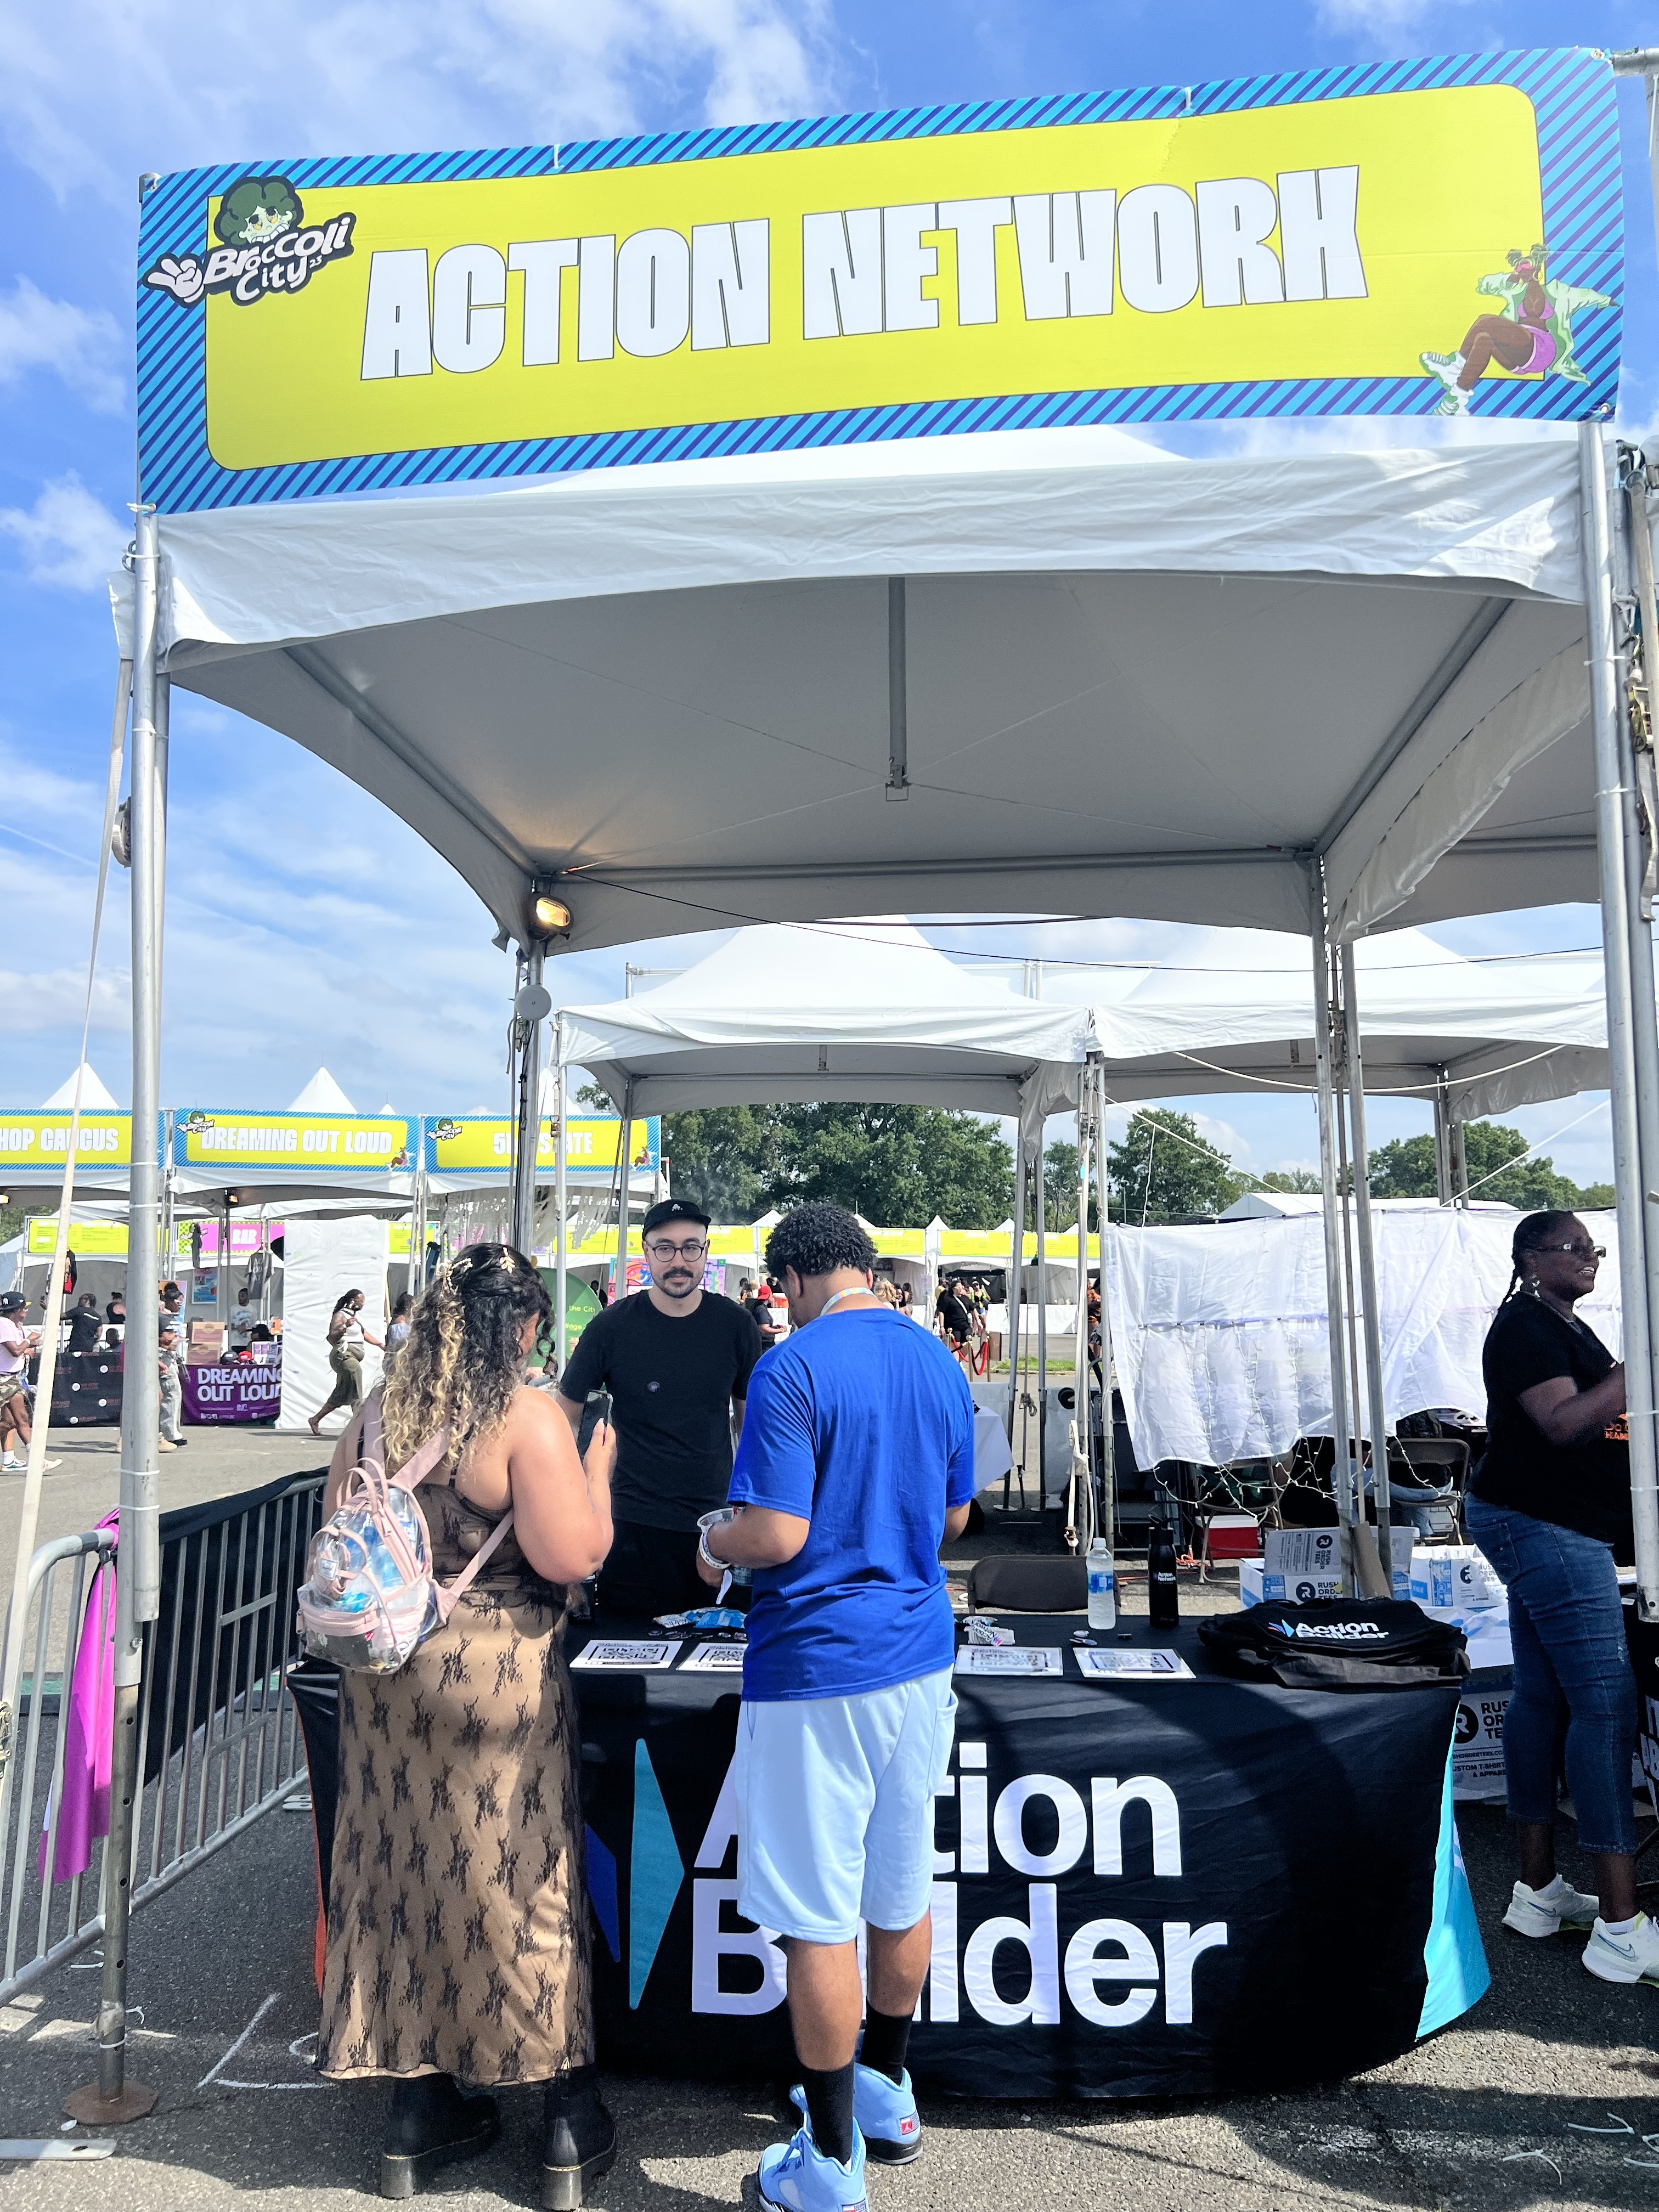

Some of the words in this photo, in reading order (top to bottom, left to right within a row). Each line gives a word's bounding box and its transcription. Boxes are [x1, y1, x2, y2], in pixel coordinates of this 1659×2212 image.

[203, 217, 351, 285] Broccoli
[236, 257, 307, 301] City
[360, 218, 771, 381] ACTION
[802, 165, 1369, 341] NETWORK
[40, 1127, 119, 1152] CAUCUS
[201, 1126, 298, 1152] DREAMING
[302, 1129, 341, 1153] OUT
[345, 1131, 393, 1154] LOUD
[539, 1132, 592, 1155] SATE
[232, 1229, 257, 1244] BAR
[198, 1385, 234, 1402] OUT
[1295, 1622, 1379, 1634] Action
[1481, 1700, 1509, 1714] RUS
[1485, 1728, 1503, 1740] TE
[1478, 1762, 1504, 1770] T-SHIRT
[691, 1878, 1228, 2027] Blder
